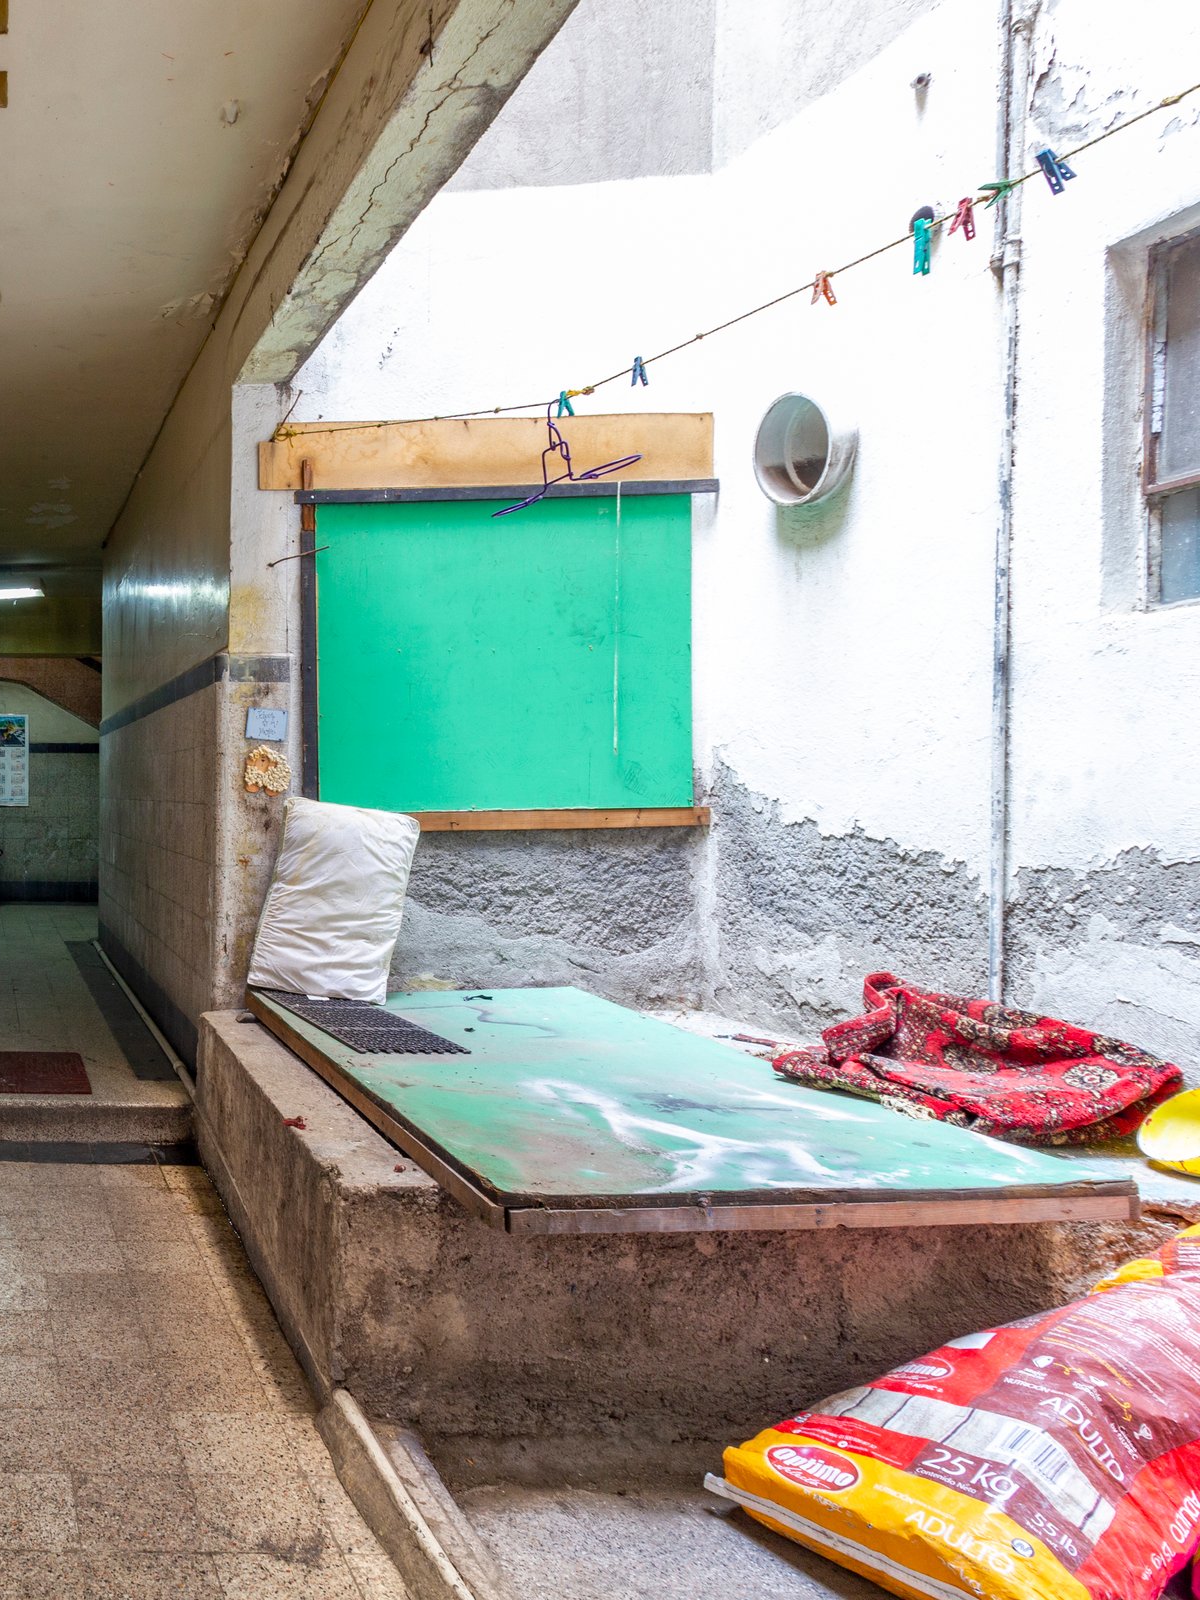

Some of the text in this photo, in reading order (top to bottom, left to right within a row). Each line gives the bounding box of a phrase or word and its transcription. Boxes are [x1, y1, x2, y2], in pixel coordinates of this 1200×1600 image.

[1039, 1397, 1125, 1481] ADULTO
[915, 1467, 977, 1495] Contenido Neto
[921, 1448, 974, 1477] 25
[970, 1462, 1021, 1503] kg
[904, 1510, 1015, 1575] ADULTO
[1030, 1513, 1078, 1558] 55 lb
[1169, 1490, 1200, 1543] ADULTO
